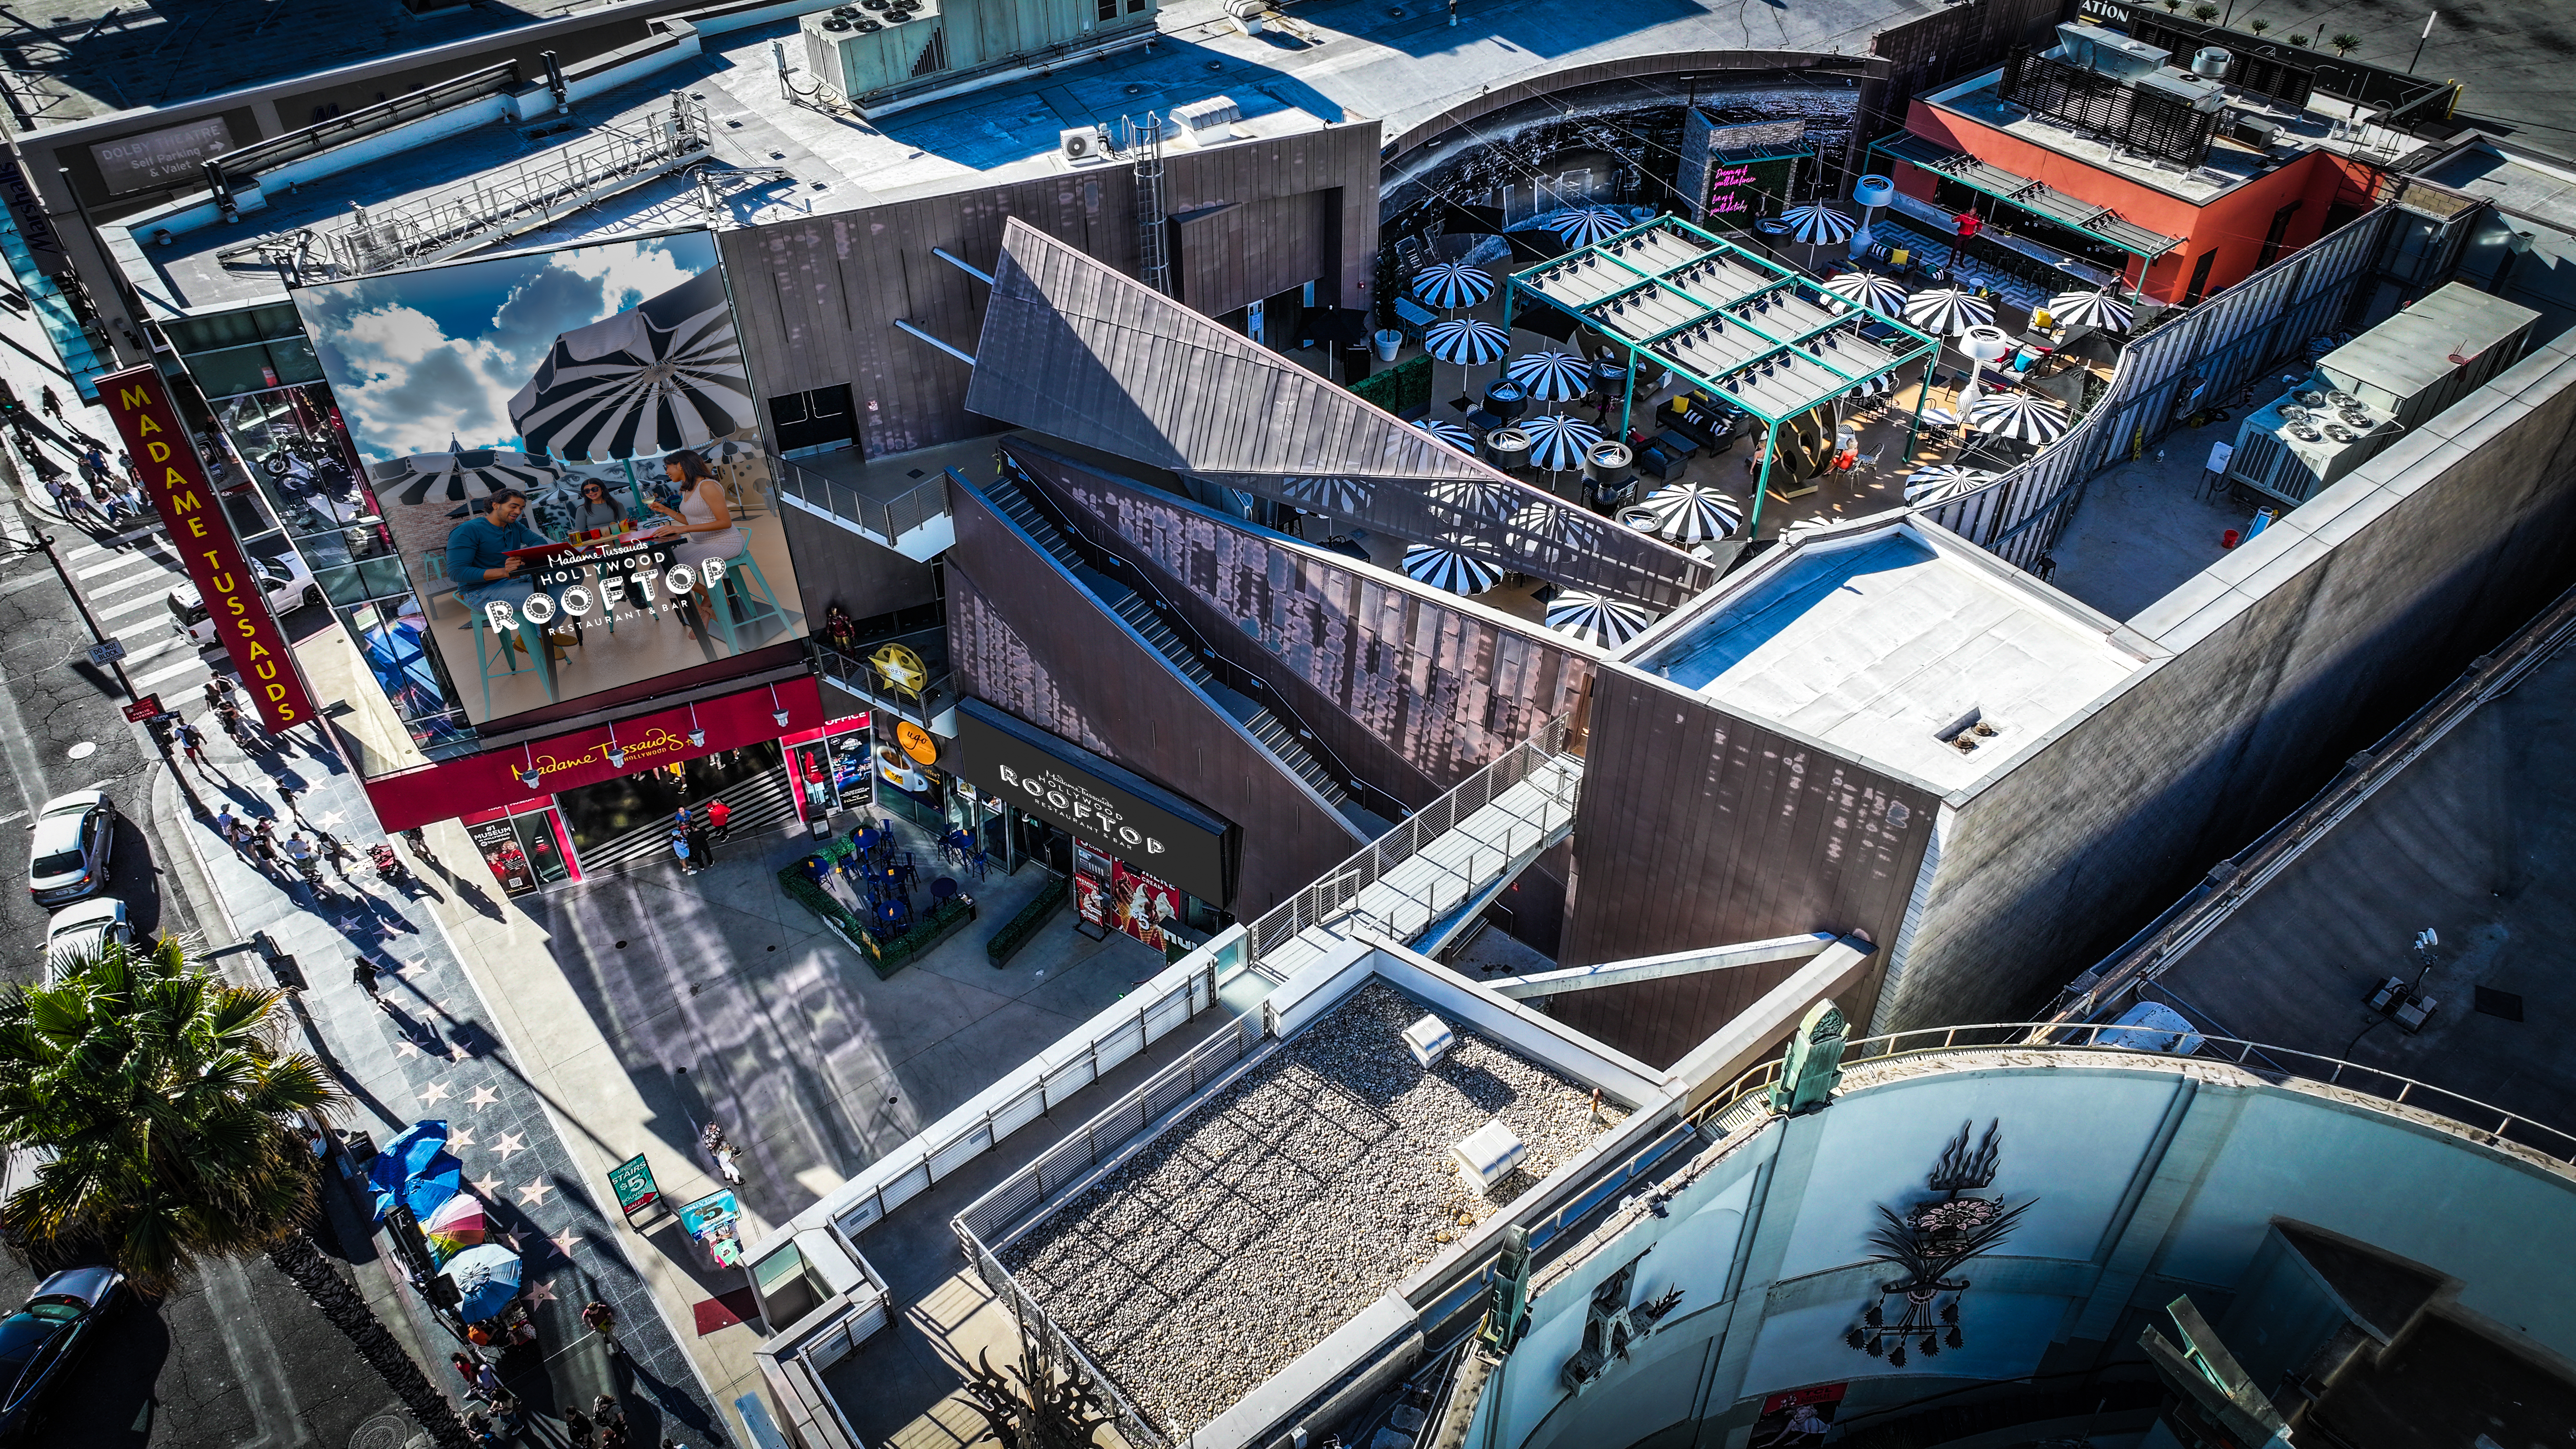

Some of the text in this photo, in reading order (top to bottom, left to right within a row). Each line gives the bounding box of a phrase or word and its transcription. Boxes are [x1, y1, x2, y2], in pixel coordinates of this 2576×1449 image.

[101, 125, 221, 161] DOLBY THEATRE
[131, 147, 201, 169] Self Parking
[150, 161, 192, 177] & Valet
[120, 384, 295, 722] MADAME TUSSAUDS
[547, 538, 648, 568] Madame Tussauds
[540, 552, 665, 585] HOLLYWOOD
[484, 557, 726, 633] ROOFTOP
[548, 600, 688, 636] RESTAURANT & BAR
[93, 643, 117, 655] DO NOT
[98, 649, 119, 660] BLOCK
[132, 711, 154, 721] PARKING
[133, 708, 150, 717] PUBLIC
[825, 711, 866, 726] OFFICE
[588, 728, 684, 760] Tssauds
[902, 731, 928, 750] ugo
[624, 747, 666, 762] HOLLYWOOD
[891, 772, 903, 781] ugo
[920, 765, 940, 779] Coffee?
[1038, 774, 1123, 821] HOLLYWOOD
[1046, 769, 1113, 809] Madame Tussauds
[1000, 765, 1165, 854] ROOFTOP
[474, 826, 512, 840] MUSEUM
[1034, 798, 1099, 833] RESTAURANT
[1113, 837, 1132, 850] BAR
[483, 832, 510, 841] HOLLYWOOD
[1141, 877, 1163, 891] CREAM
[1131, 908, 1150, 930] $5
[612, 1161, 647, 1185] STAIRS
[618, 1160, 637, 1174] UNDER
[620, 1173, 646, 1192] $5
[627, 1199, 644, 1210] SALE!
[681, 1190, 732, 1215] SOUVENIRS
[1804, 1387, 1832, 1396] TCL
